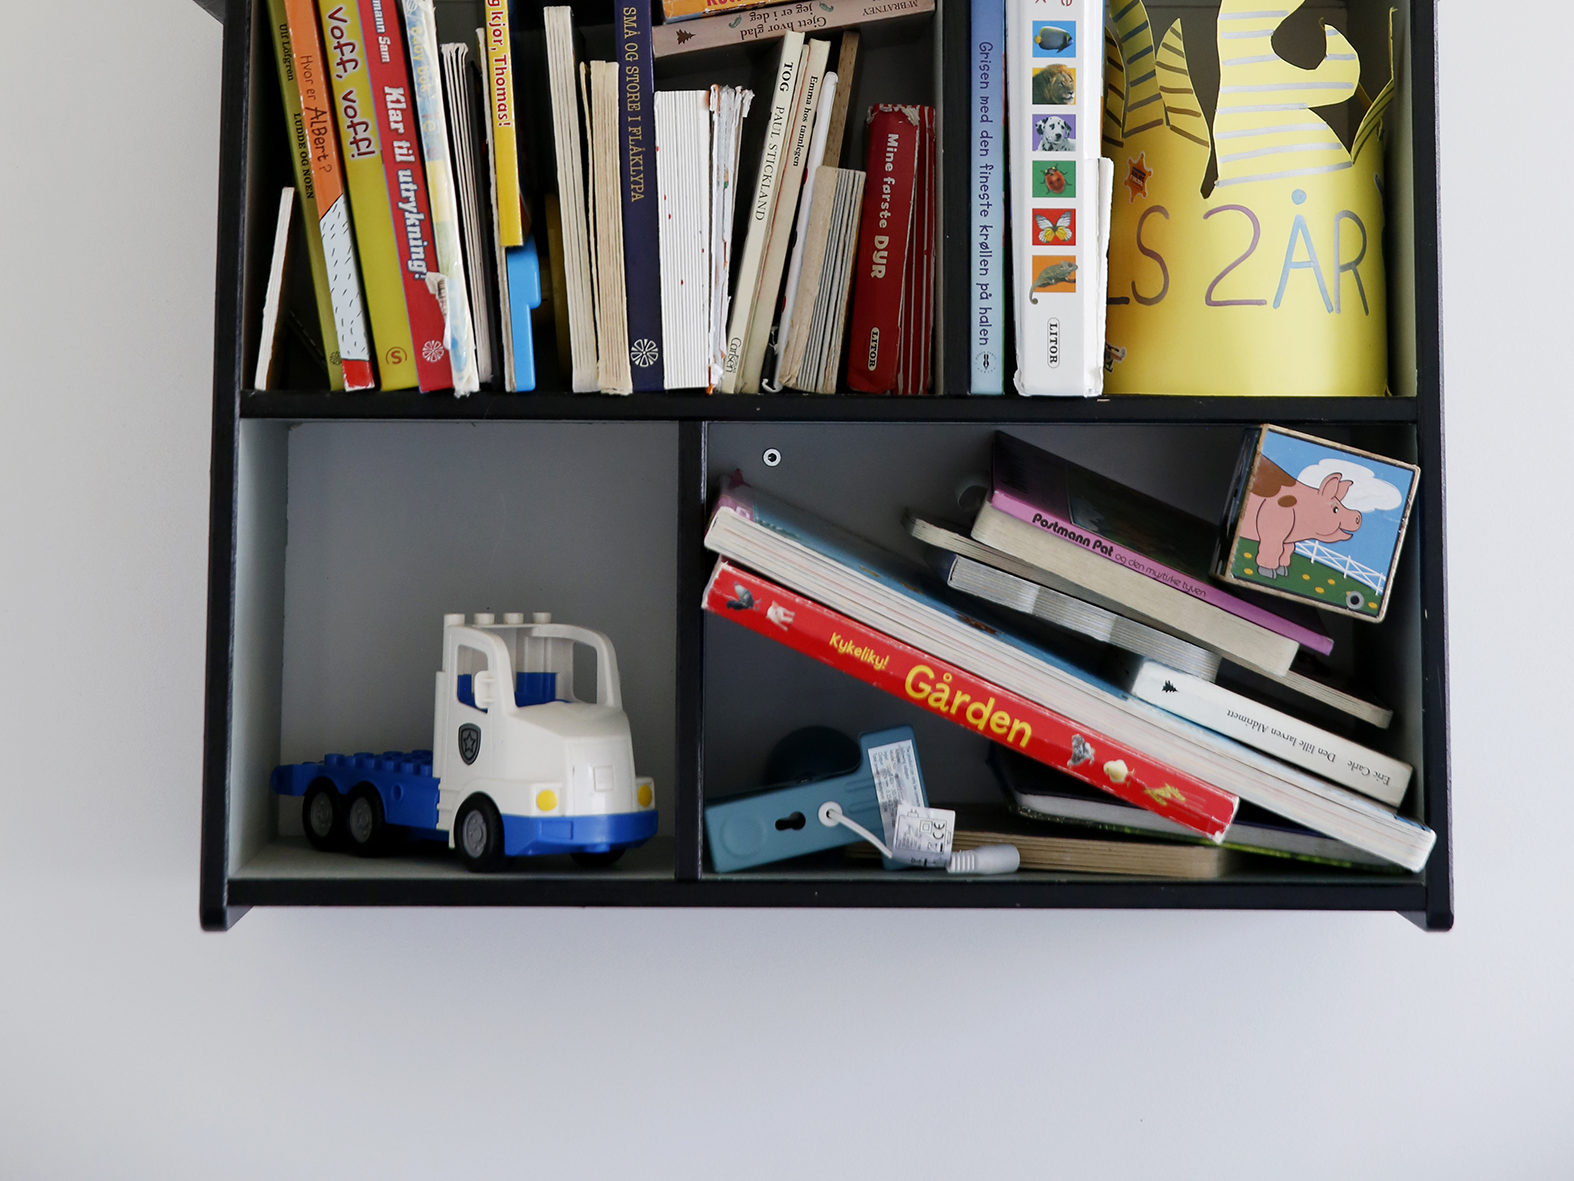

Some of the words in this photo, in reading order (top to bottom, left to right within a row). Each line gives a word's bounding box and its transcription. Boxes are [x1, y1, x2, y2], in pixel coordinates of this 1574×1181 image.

[623, 6, 641, 39] SMÅ
[749, 11, 769, 22] deg
[781, 8, 793, 16] er
[797, 2, 814, 14] jeg
[798, 16, 827, 30] Gjett
[279, 23, 288, 42] Ulf
[740, 23, 765, 40] glad
[768, 19, 795, 32] hvor
[328, 6, 359, 80] Voff,
[378, 36, 391, 63] Sam
[624, 43, 639, 62] OG
[281, 45, 294, 81] Löfgren
[300, 54, 314, 86] Hvor
[307, 89, 316, 101] er
[779, 62, 794, 93] TOG
[979, 41, 993, 90] Grisen
[493, 54, 511, 127] Thomas!
[626, 65, 641, 112] STORE
[805, 75, 818, 105] Emma
[342, 90, 376, 159] voff!
[383, 86, 405, 134] Klar
[771, 105, 785, 139] PAUL
[802, 107, 812, 122] hos
[979, 95, 992, 123] med
[293, 113, 308, 149] LUDDE
[793, 124, 807, 167] tannlegen
[979, 129, 993, 157] den
[300, 151, 309, 166] OG
[393, 139, 415, 163] til
[628, 125, 646, 203] FLÅKLYPA
[884, 133, 899, 172] Mine
[302, 169, 314, 199] NOEN
[755, 143, 778, 221] STICKLAND
[979, 163, 993, 217] fineste
[397, 169, 429, 280] utrykning!
[979, 224, 993, 276] krøllen
[976, 282, 992, 301] på
[979, 307, 993, 346] halen
[727, 336, 741, 373] Carlsen
[869, 331, 878, 367] LITOR
[1048, 322, 1059, 366] LITOR
[1032, 512, 1091, 547] Postmann
[1092, 539, 1114, 557] Pat
[1115, 553, 1127, 564] og
[1128, 559, 1145, 570] den
[1182, 580, 1207, 597] tyven
[829, 632, 890, 671] Kykeliky!
[905, 664, 1032, 748] Gården
[1226, 709, 1270, 734] Aldrimett
[1271, 728, 1296, 746] larven
[1299, 739, 1315, 755] lille
[1317, 748, 1336, 763] Den
[1347, 759, 1371, 777] Carle
[1373, 771, 1391, 786] Eric
